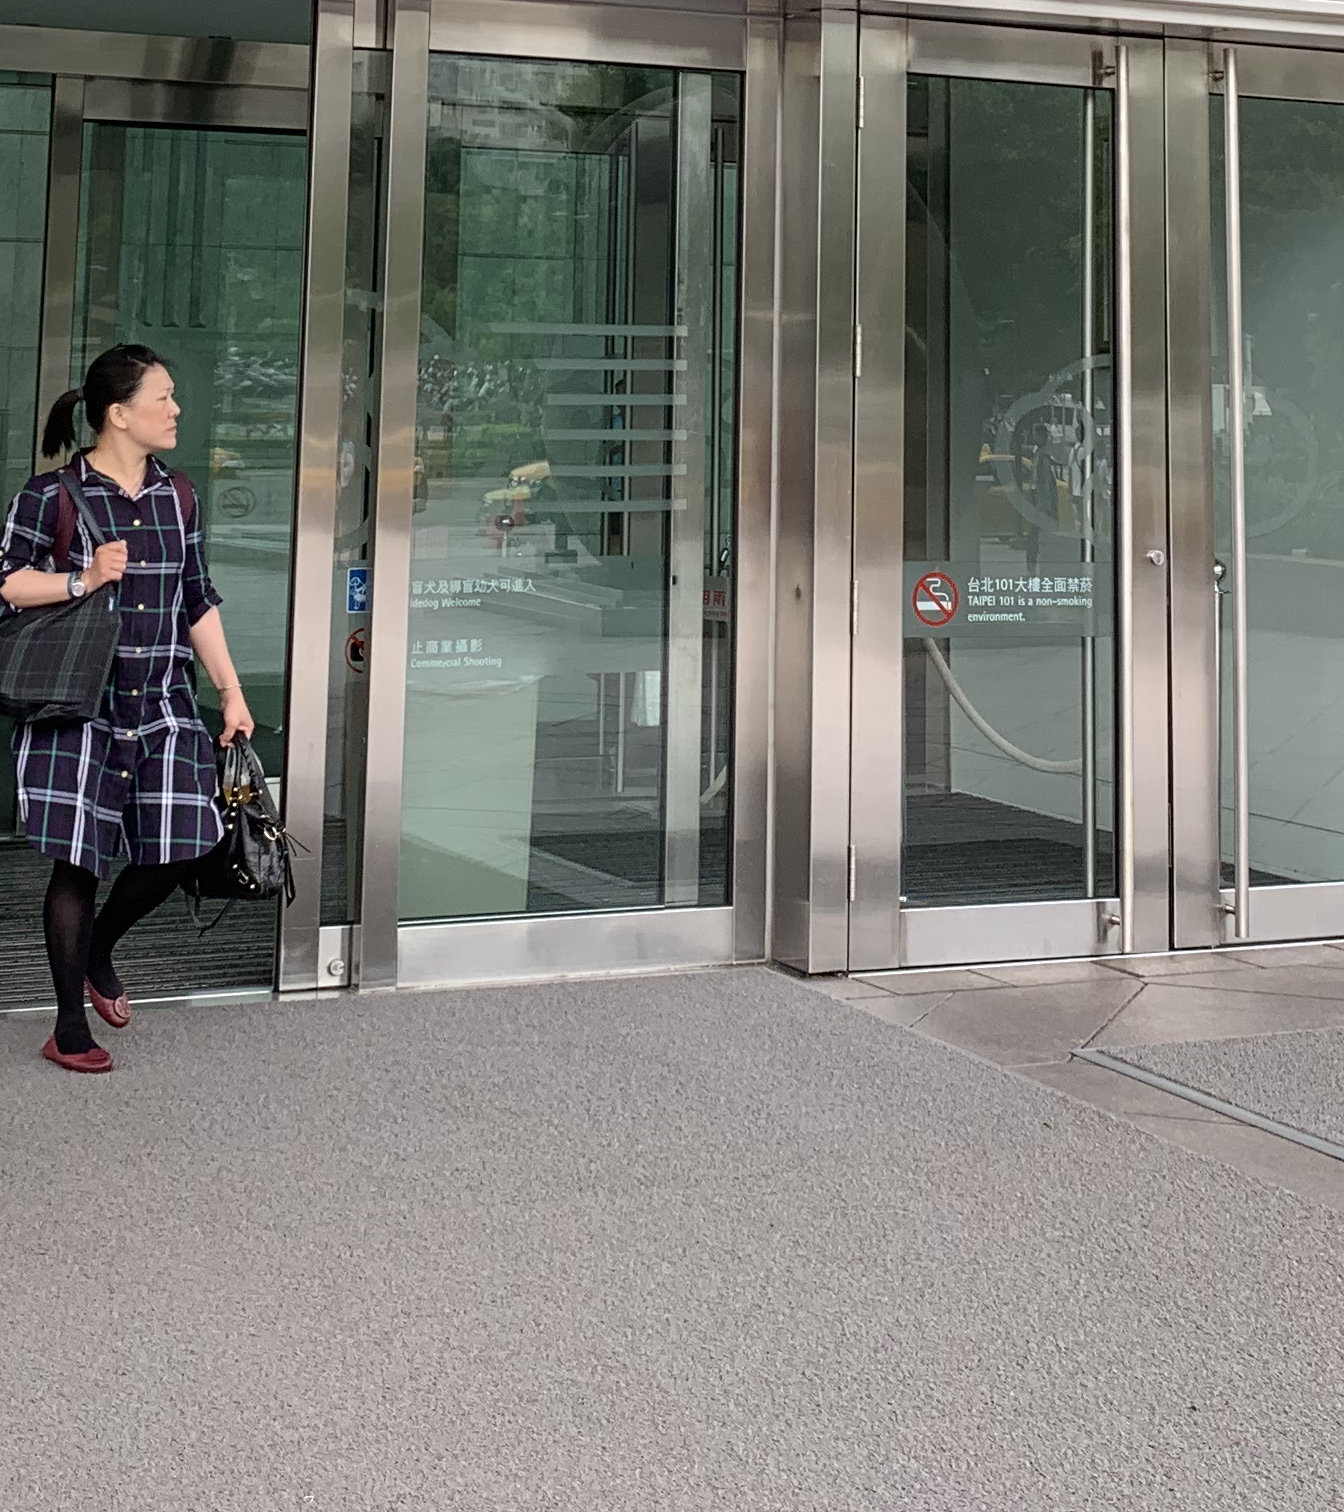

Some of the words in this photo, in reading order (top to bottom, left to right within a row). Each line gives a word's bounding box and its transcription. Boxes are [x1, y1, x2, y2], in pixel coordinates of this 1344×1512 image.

[967, 576, 1093, 593] 台北101大樓全面禁菸
[441, 598, 482, 607] Welcome
[967, 595, 996, 606] TAIPEI
[999, 595, 1015, 606] 101
[1017, 595, 1026, 606] is
[1035, 595, 1093, 608] non-smoking
[967, 611, 1026, 622] environment.
[410, 657, 461, 668] Commercial
[463, 656, 503, 668] Shooting
